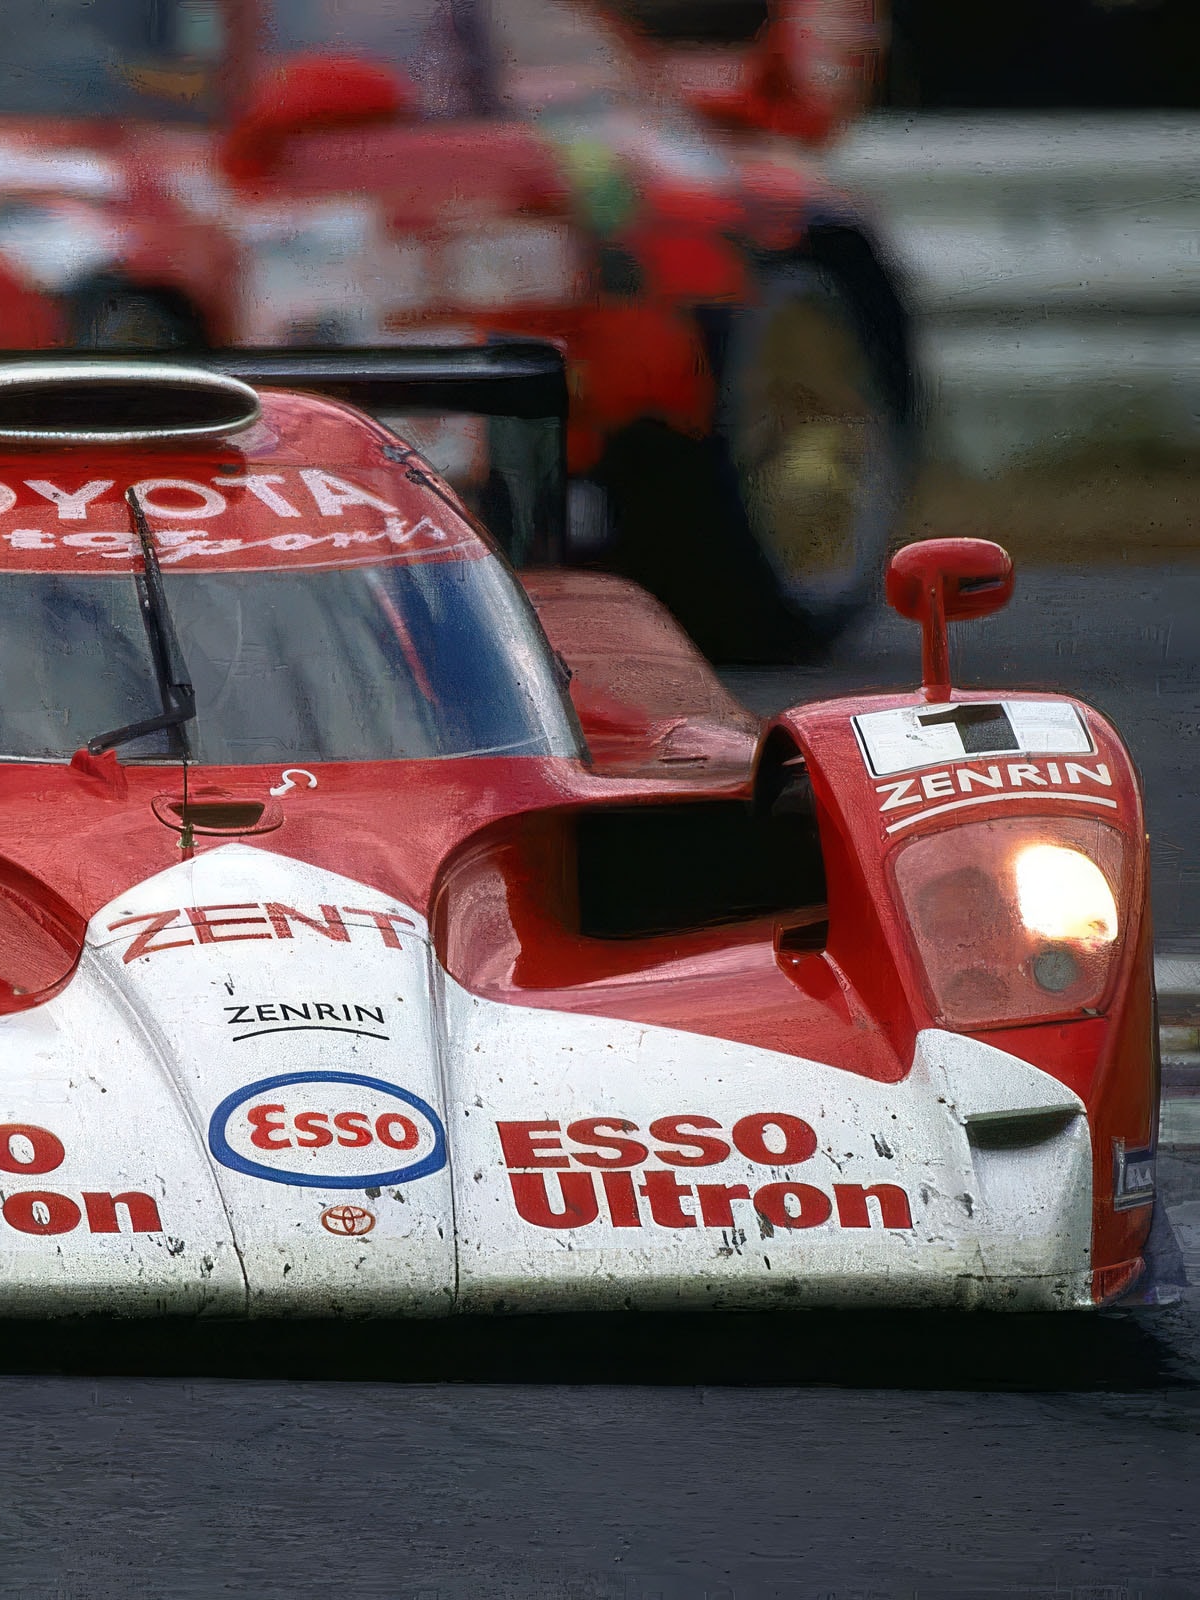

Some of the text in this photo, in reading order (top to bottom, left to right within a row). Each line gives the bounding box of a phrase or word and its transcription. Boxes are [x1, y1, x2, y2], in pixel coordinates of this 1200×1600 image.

[875, 762, 1113, 812] ZENRIN
[107, 902, 416, 965] ZENT
[223, 1003, 386, 1025] ZENRIN
[495, 1112, 818, 1168] ESSO
[508, 1170, 914, 1230] Ultron
